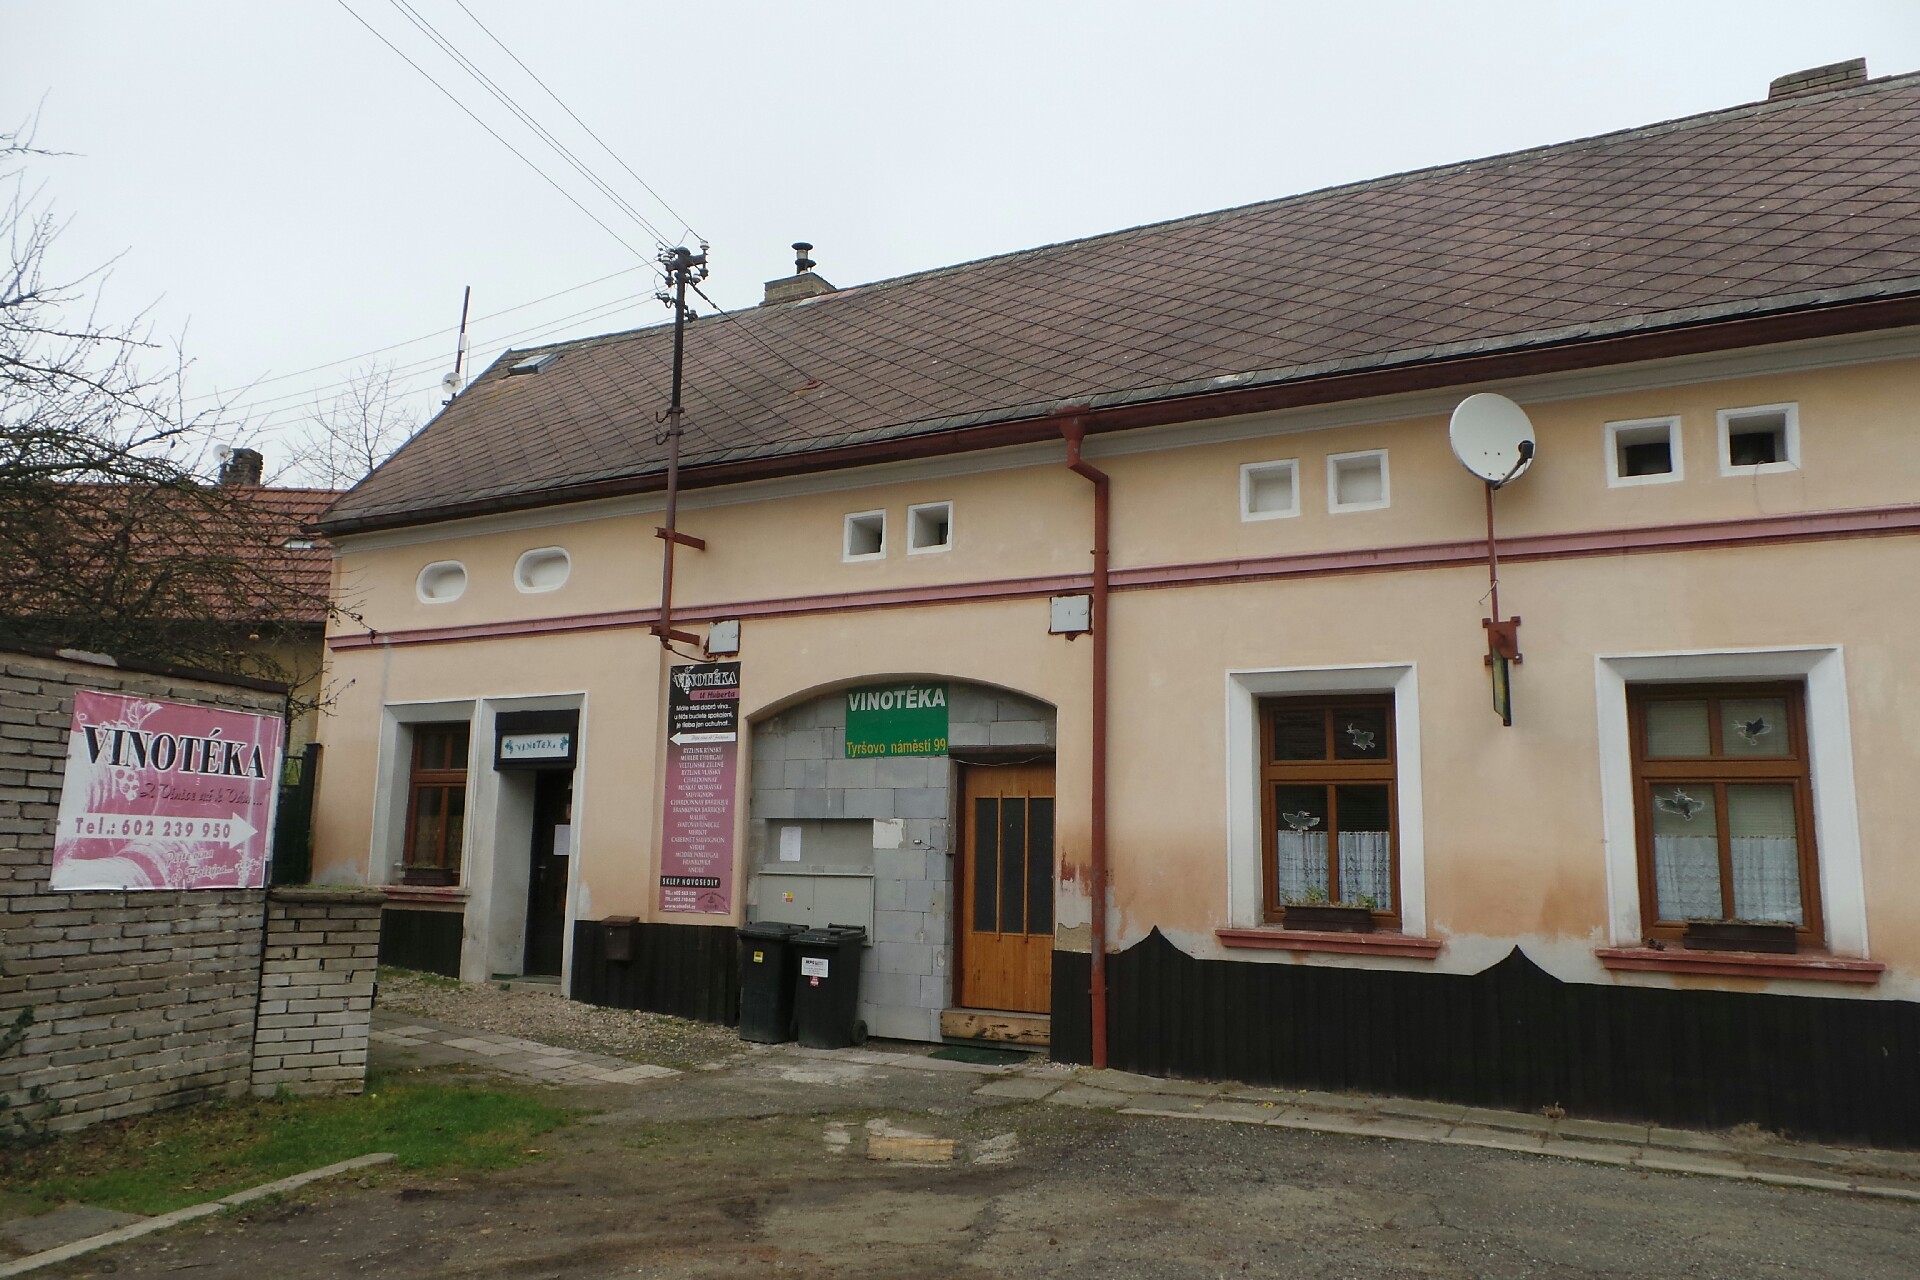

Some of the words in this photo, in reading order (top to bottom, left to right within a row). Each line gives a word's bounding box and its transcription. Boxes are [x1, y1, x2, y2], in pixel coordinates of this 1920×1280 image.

[673, 669, 737, 688] VINOTÉKA
[848, 685, 946, 711] VINOTÉKA
[82, 725, 266, 779] VINOTÉKA
[847, 741, 886, 758] Tyršovo
[890, 738, 931, 754] náměstí
[933, 738, 946, 751] 99
[75, 816, 115, 835] Tel.:
[121, 819, 154, 836] 602
[162, 821, 194, 837] 239
[202, 823, 231, 839] 950
[662, 877, 680, 885] SKLEP
[681, 878, 718, 887] NOVOSEDLY
